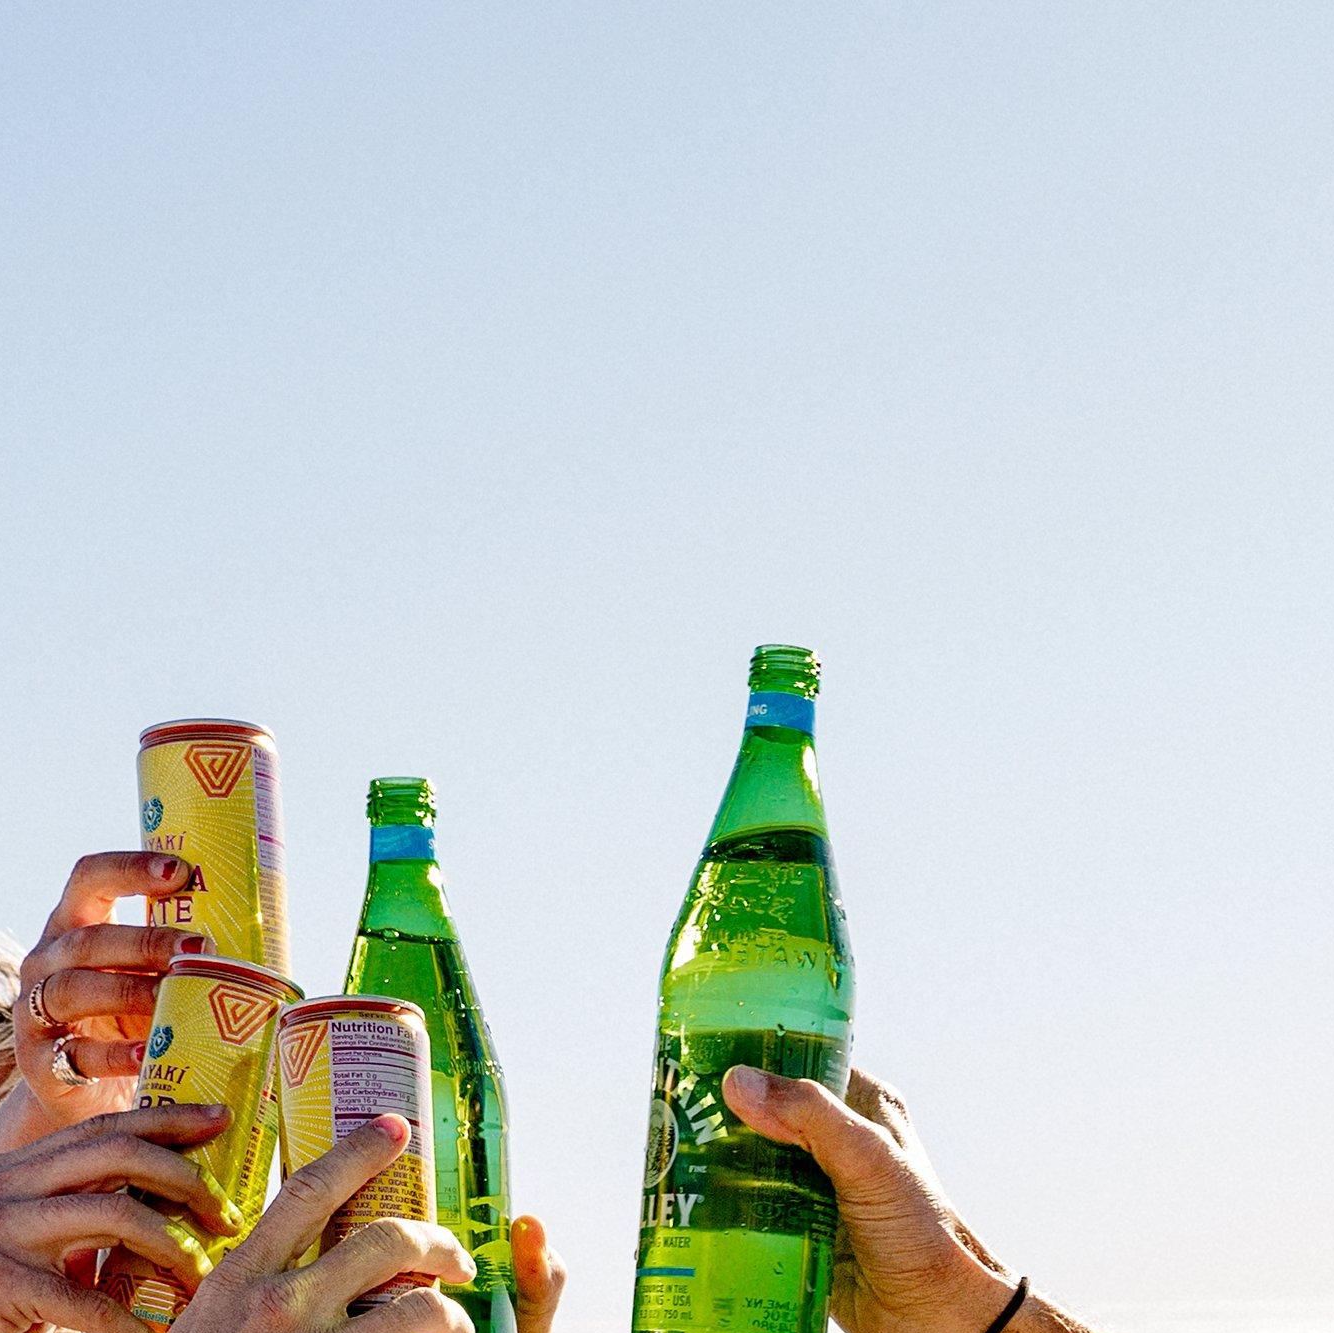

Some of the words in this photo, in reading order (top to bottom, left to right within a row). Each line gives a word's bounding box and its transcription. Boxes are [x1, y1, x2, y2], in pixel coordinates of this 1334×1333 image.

[332, 1022, 393, 1035] Nutrition
[352, 1088, 398, 1099] Carbohydrate
[338, 1097, 361, 1105] Sugars
[663, 1236, 690, 1249] WATER
[674, 1285, 688, 1294] THE
[673, 1295, 691, 1306] USA
[663, 1309, 679, 1319] 750
